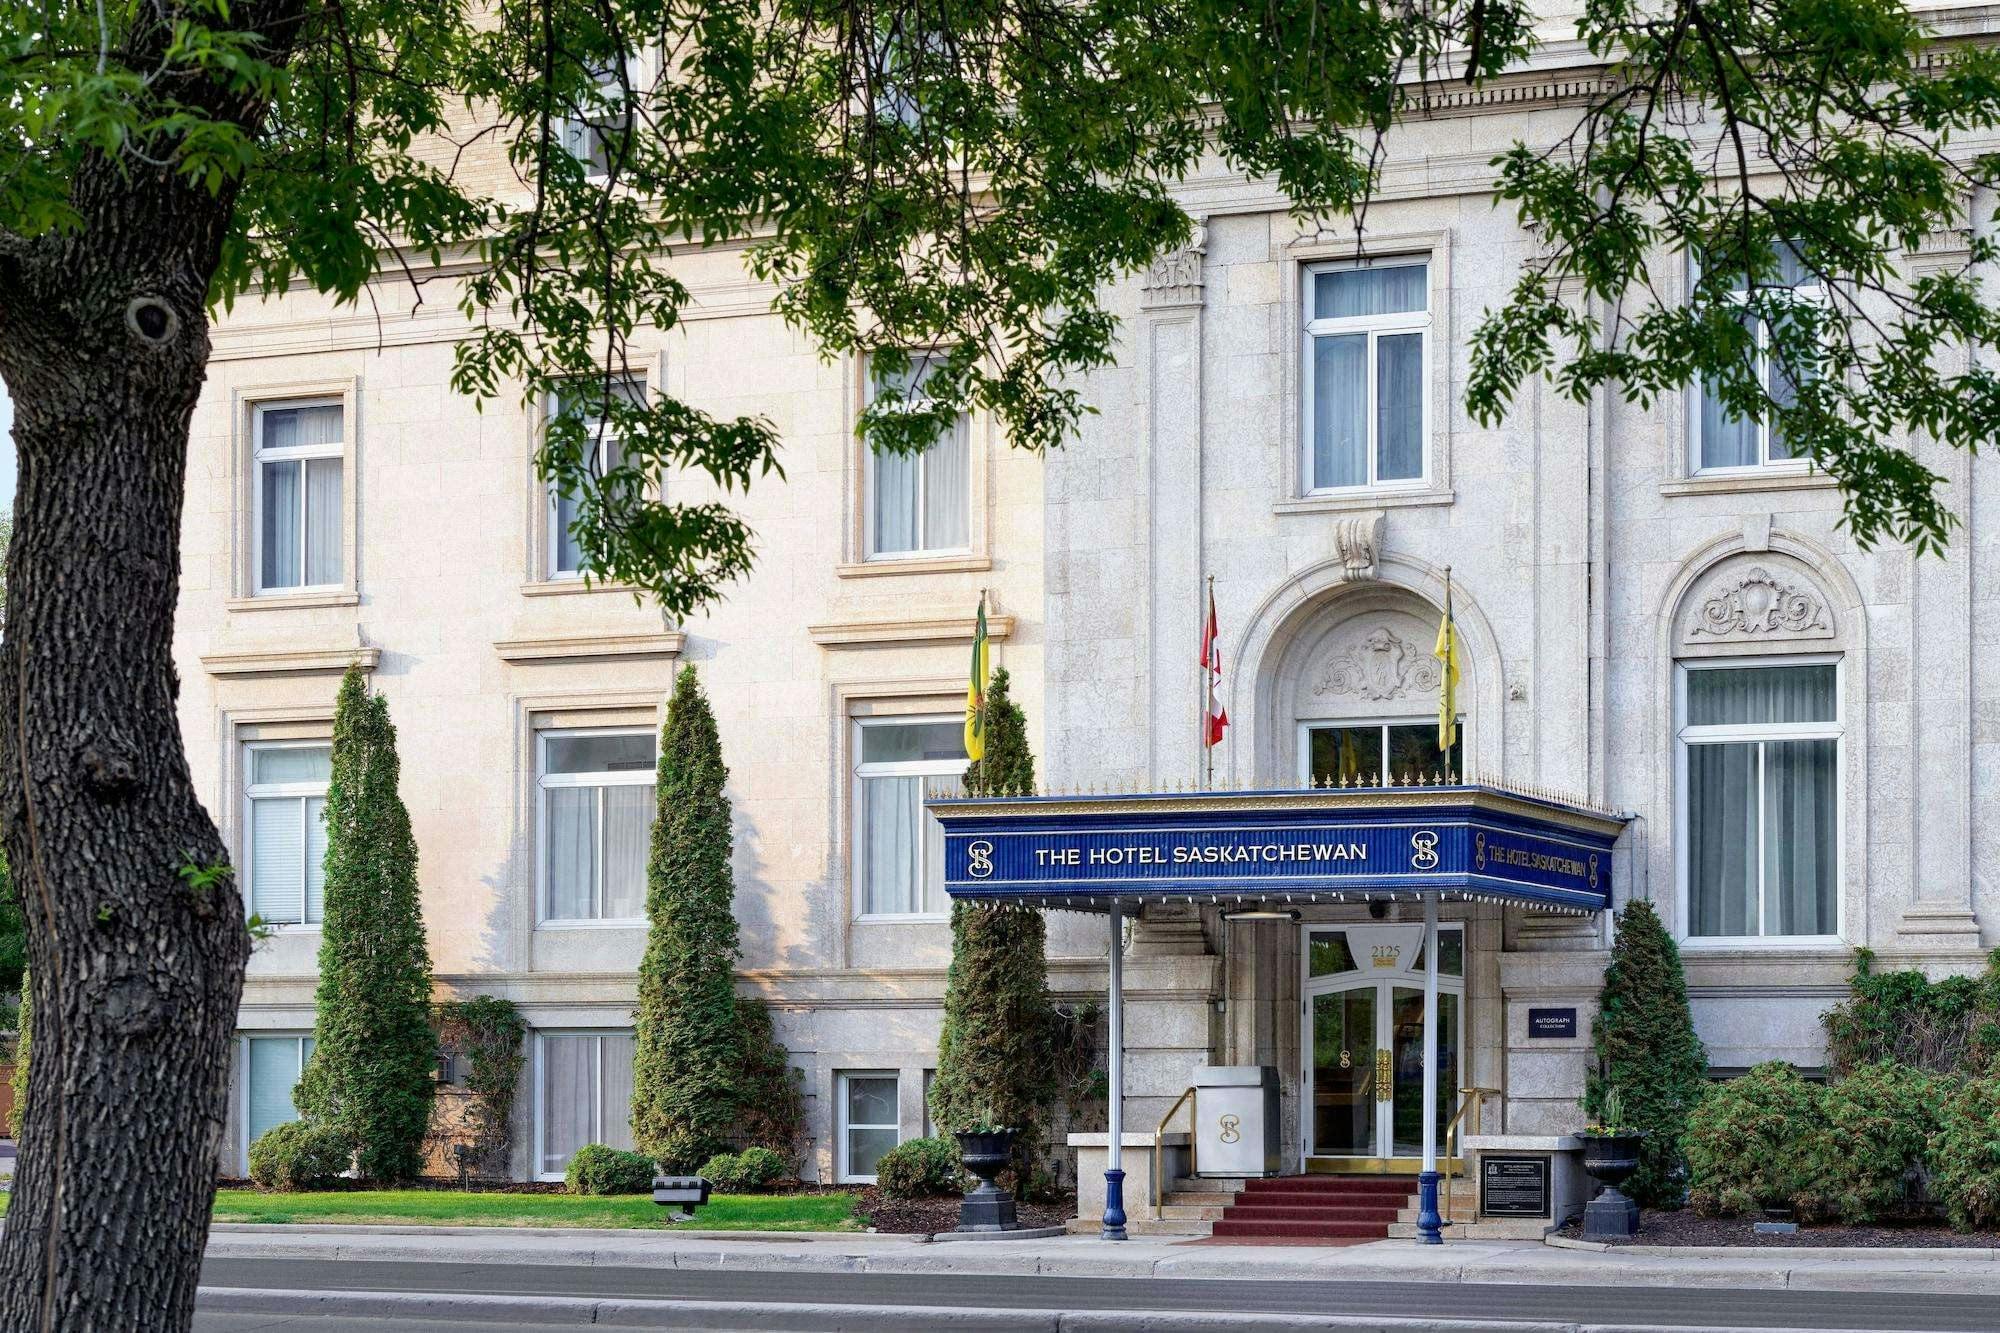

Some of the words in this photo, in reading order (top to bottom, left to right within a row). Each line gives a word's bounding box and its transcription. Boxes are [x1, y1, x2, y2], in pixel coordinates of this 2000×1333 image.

[1036, 849, 1081, 865] THE
[1090, 847, 1167, 865] HOTEL
[1173, 843, 1367, 863] SASKATCHEWAN
[1489, 845, 1505, 862] THE
[1506, 849, 1530, 867] HOTEL
[1530, 853, 1586, 877] SASKATCHEWAN
[1371, 945, 1401, 958] 2125
